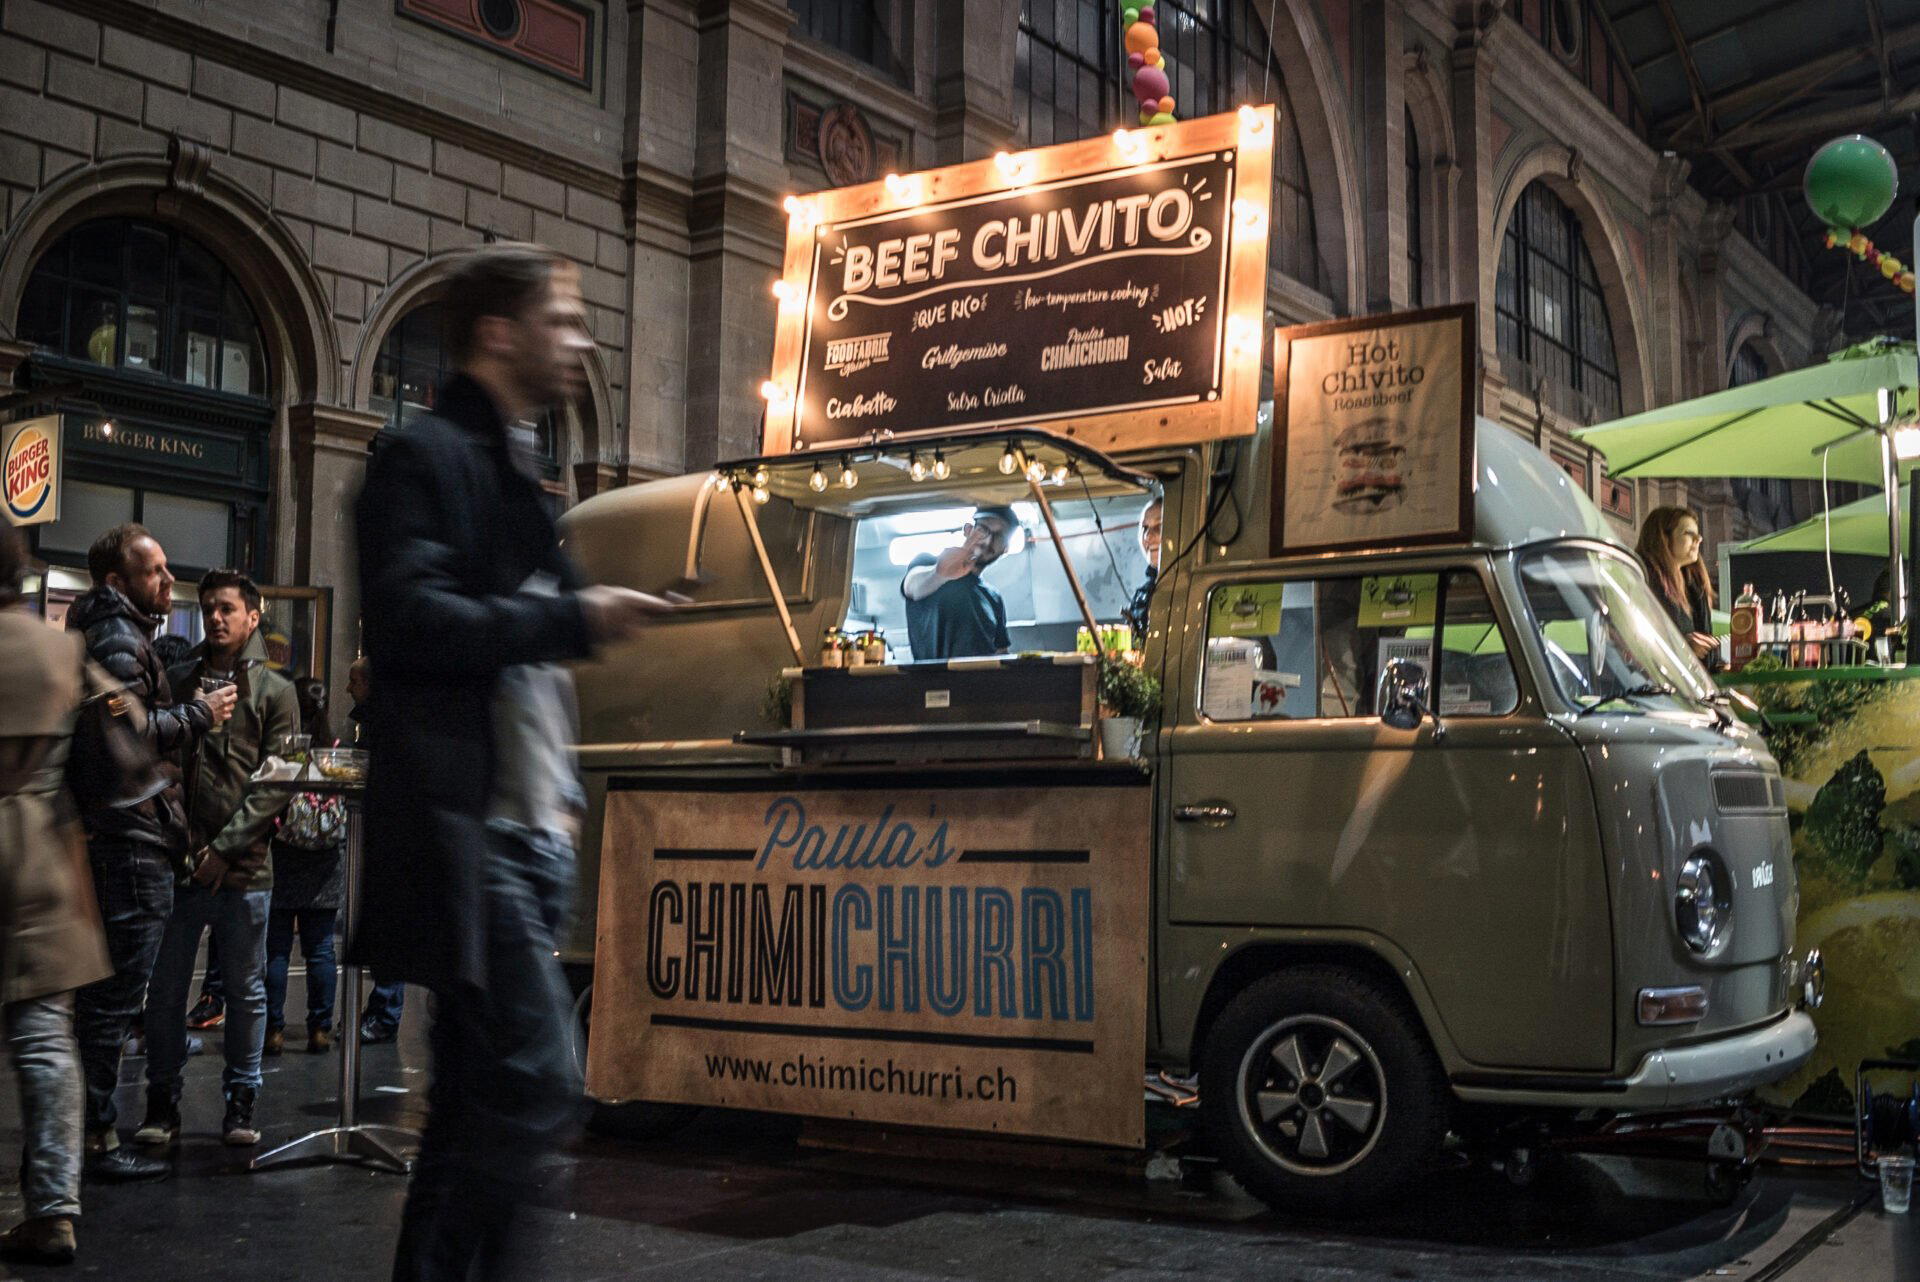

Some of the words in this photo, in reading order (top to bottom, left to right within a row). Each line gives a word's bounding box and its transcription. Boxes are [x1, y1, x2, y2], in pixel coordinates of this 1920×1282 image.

[843, 228, 961, 294] BEEF
[972, 188, 1193, 271] CHIVITO
[1110, 280, 1150, 308] cooking
[918, 304, 946, 329] QUE
[951, 294, 980, 320] RICO
[826, 337, 890, 366] FOODFABRIK
[921, 341, 1008, 369] Grillgemüse
[1041, 335, 1130, 372] CHIMICHURRI
[1346, 340, 1400, 367] Hot
[1143, 357, 1183, 385] Salat
[1322, 365, 1425, 395] Chivito
[826, 391, 898, 419] Ciabatta
[947, 391, 980, 412] Salsa
[984, 384, 1027, 408] Criolla
[8, 437, 49, 478] BURGER
[160, 437, 204, 459] KING
[8, 456, 50, 501] KING
[756, 796, 955, 871] Paula's
[646, 880, 1096, 1023] CHIMICHURRI
[705, 1054, 1017, 1103] www.chimichurri.ch
